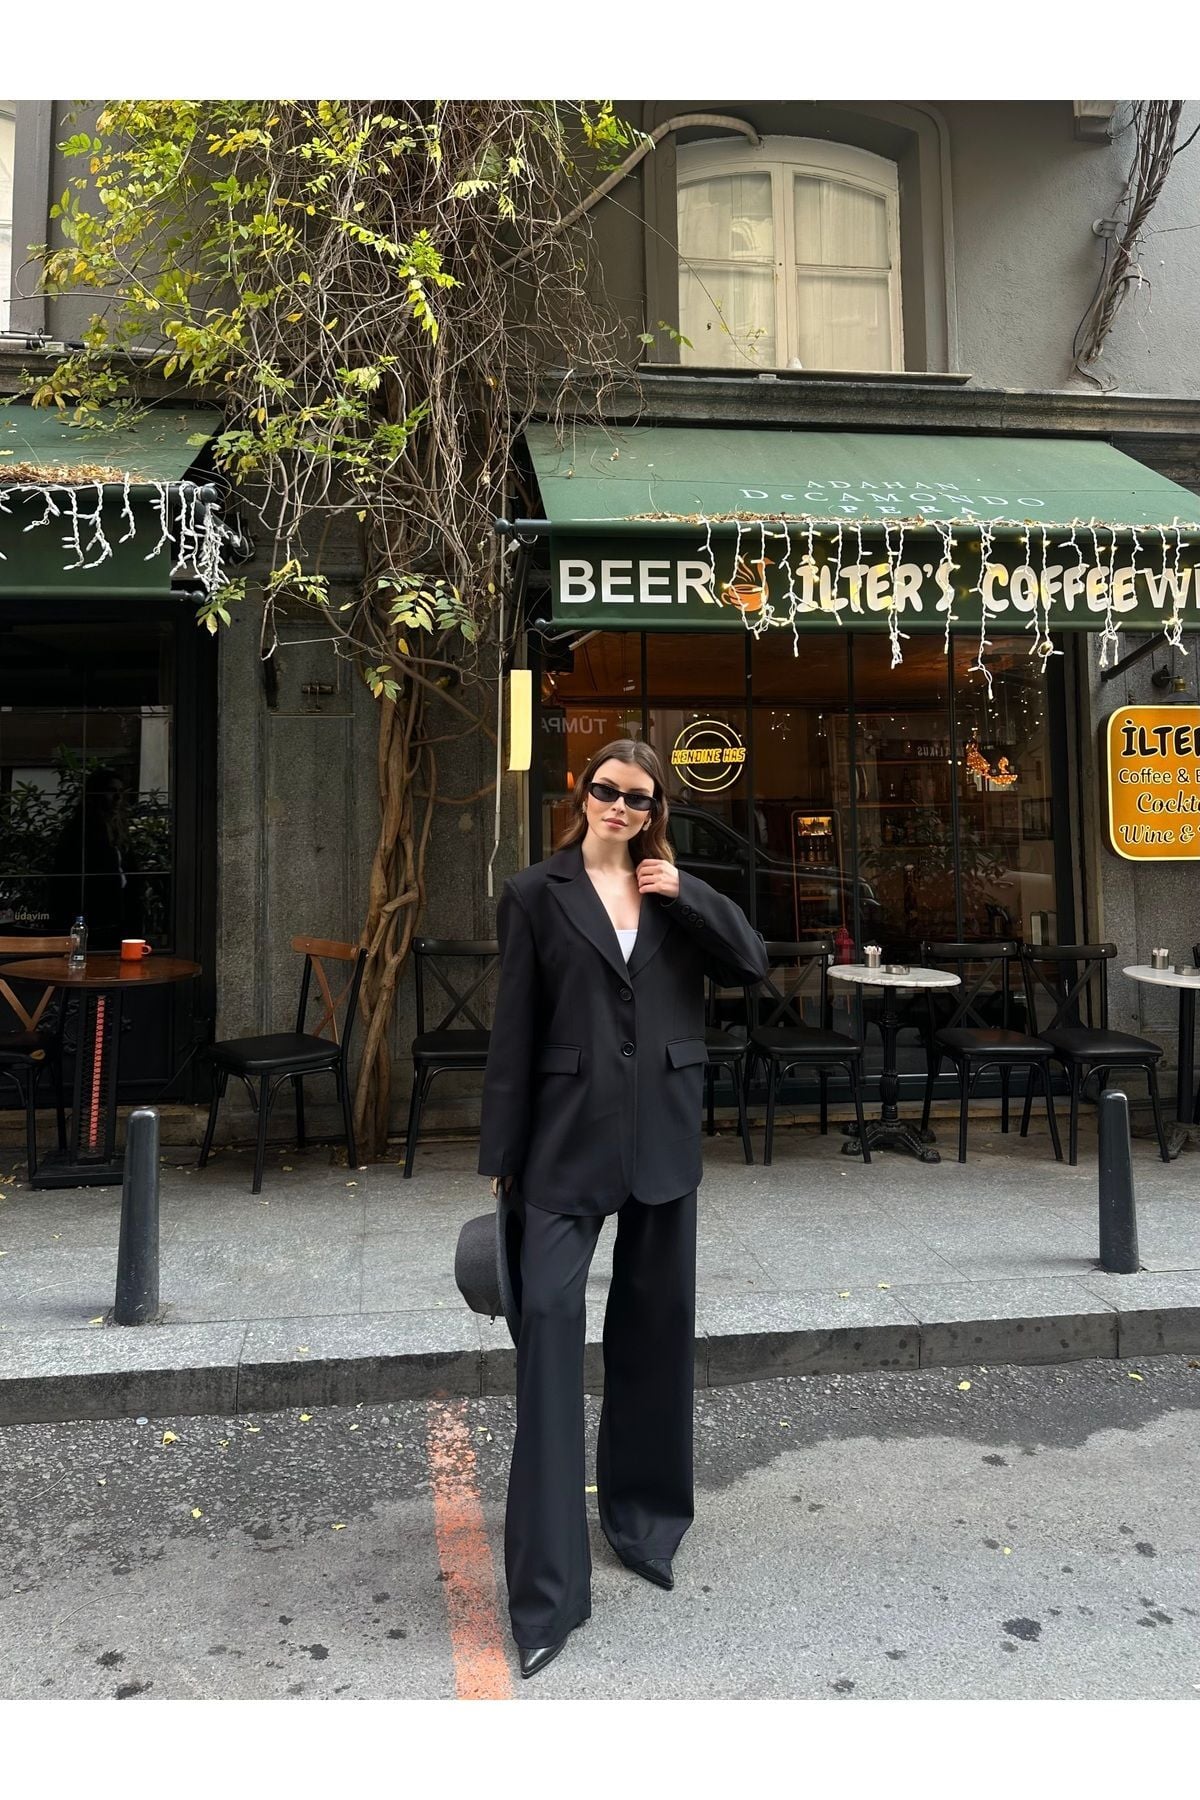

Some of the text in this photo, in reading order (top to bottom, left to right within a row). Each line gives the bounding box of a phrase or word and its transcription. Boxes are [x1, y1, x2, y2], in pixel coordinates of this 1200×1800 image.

[807, 480, 960, 491] ADAHAN
[739, 488, 1046, 507] DeCAMONDO
[838, 505, 982, 516] PERA
[559, 559, 715, 604] BEER
[982, 563, 1139, 613] COFFEE
[722, 747, 746, 763] HAS
[1119, 767, 1171, 785] Coffee
[1177, 767, 1190, 784] &
[1119, 824, 1196, 843] Wine &
